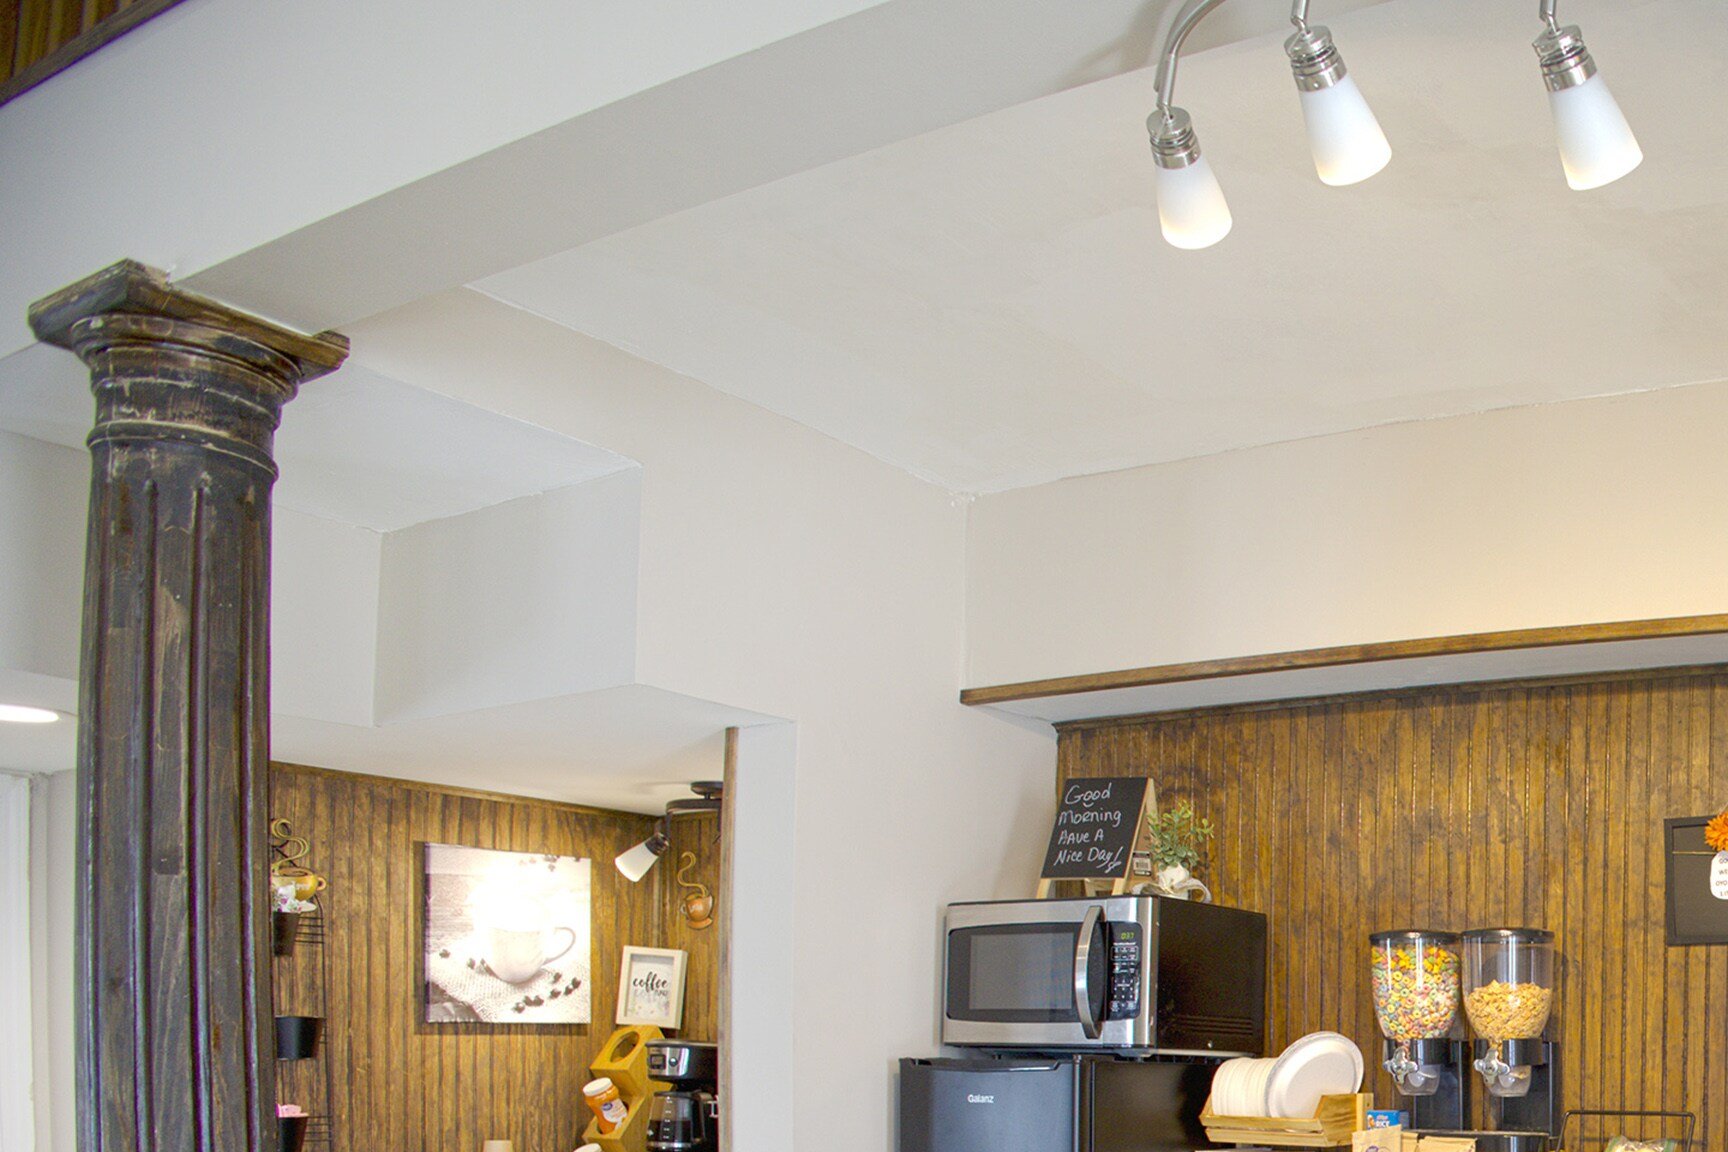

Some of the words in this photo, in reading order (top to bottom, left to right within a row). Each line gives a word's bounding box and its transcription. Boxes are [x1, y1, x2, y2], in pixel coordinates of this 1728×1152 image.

[1065, 782, 1112, 805] Good
[1094, 828, 1104, 842] A
[632, 971, 669, 993] coffee
